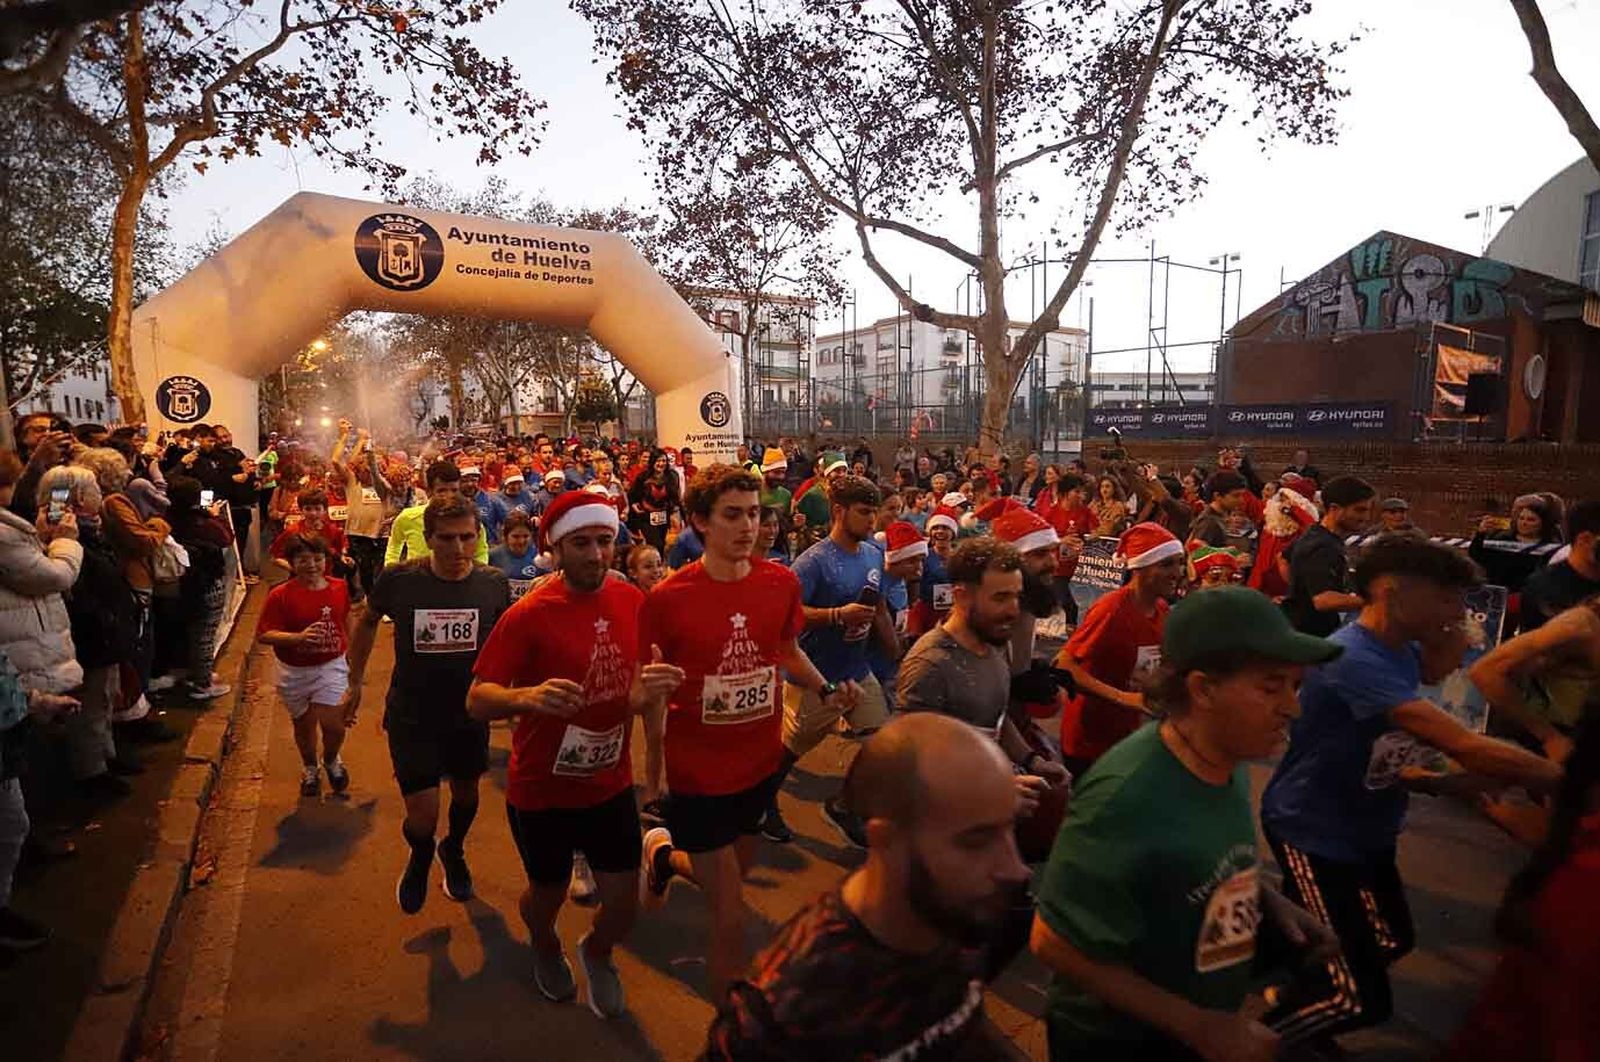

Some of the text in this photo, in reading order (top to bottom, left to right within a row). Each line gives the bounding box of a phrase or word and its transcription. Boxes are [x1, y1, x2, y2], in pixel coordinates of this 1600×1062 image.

[447, 227, 591, 254] Ayuntamiento
[491, 248, 591, 271] de Huelva
[524, 270, 539, 281] de
[542, 272, 594, 285] Deportes
[1107, 415, 1143, 423] HYUNDAI
[1167, 413, 1207, 422] HYUNDAI
[1246, 412, 1294, 421] HYUNDAI
[1328, 410, 1385, 419] HYUNDAI
[1082, 565, 1122, 581] Huelva
[441, 622, 472, 640] 168
[734, 684, 769, 709] 285
[588, 740, 619, 764] 322
